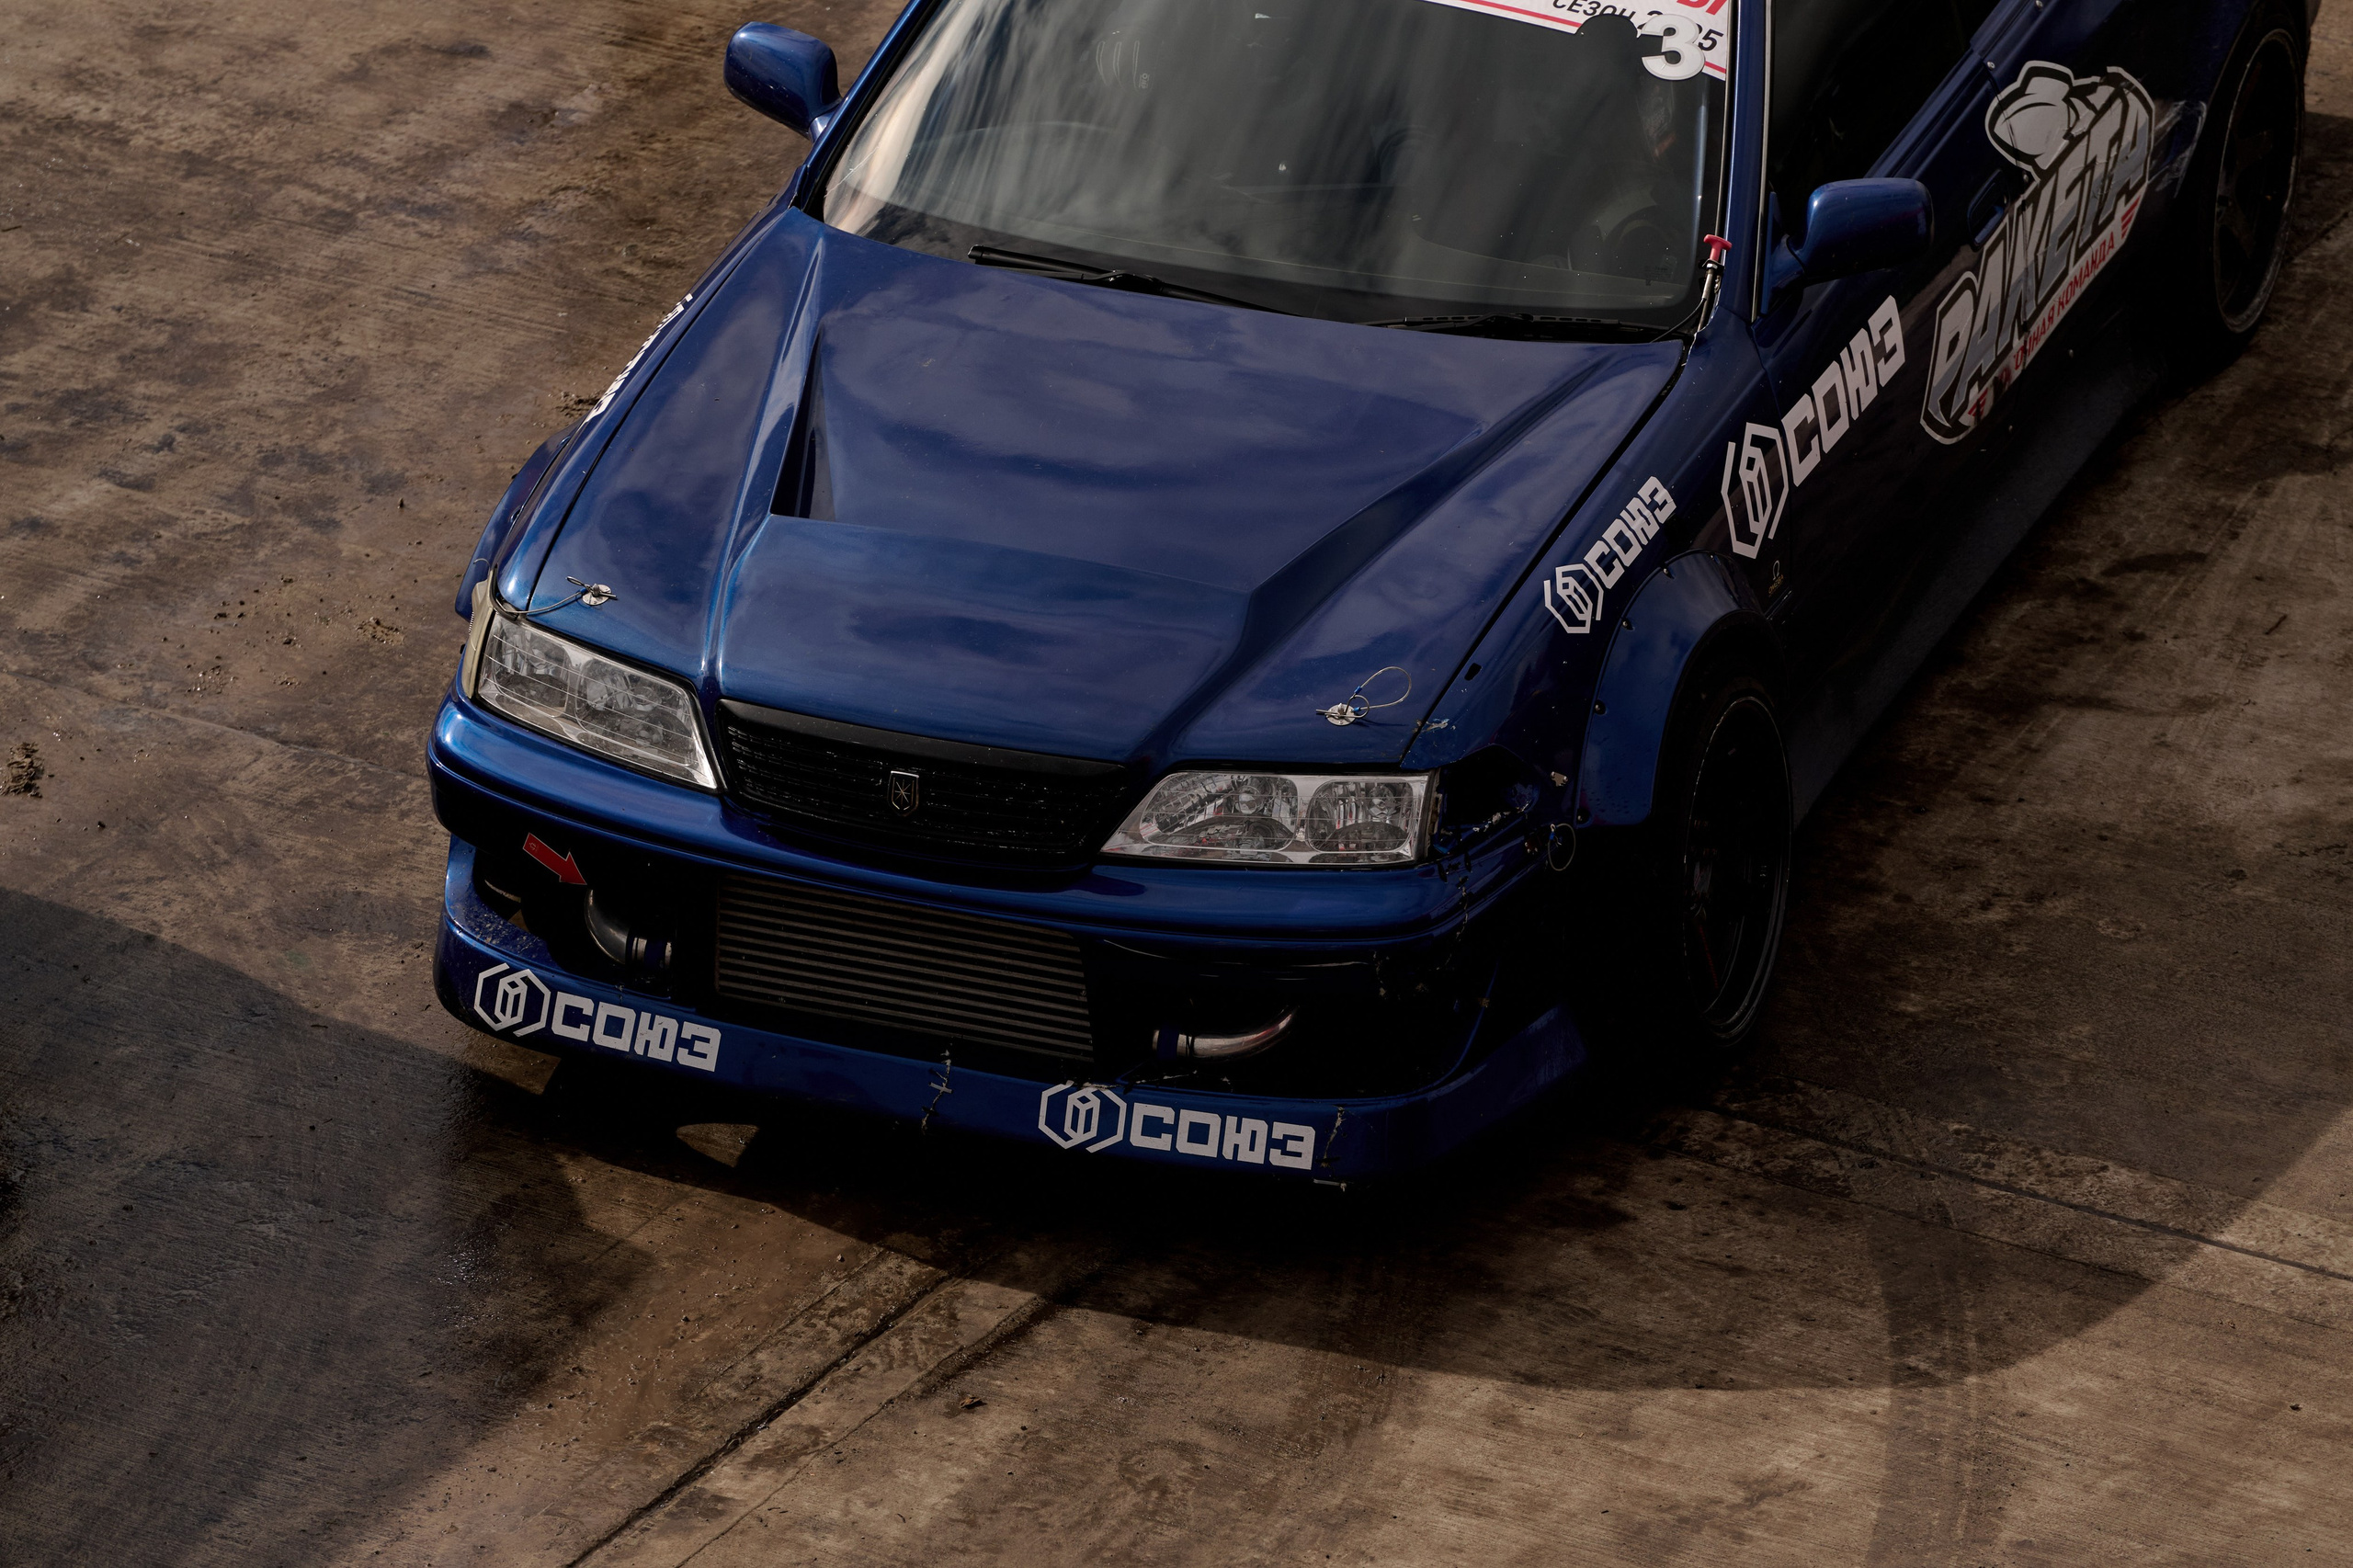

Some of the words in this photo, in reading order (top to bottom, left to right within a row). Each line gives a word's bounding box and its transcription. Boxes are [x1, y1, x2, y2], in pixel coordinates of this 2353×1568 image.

[1641, 14, 1706, 81] 3
[1927, 86, 2149, 428] РАКЕТА
[2057, 231, 2115, 317] КОМАНДА
[1781, 294, 1905, 487] СОЮЗ
[1584, 476, 1677, 589] СОЮЗ
[551, 991, 722, 1072] СОЮЗ
[1130, 1102, 1315, 1170] СОЮЗ
